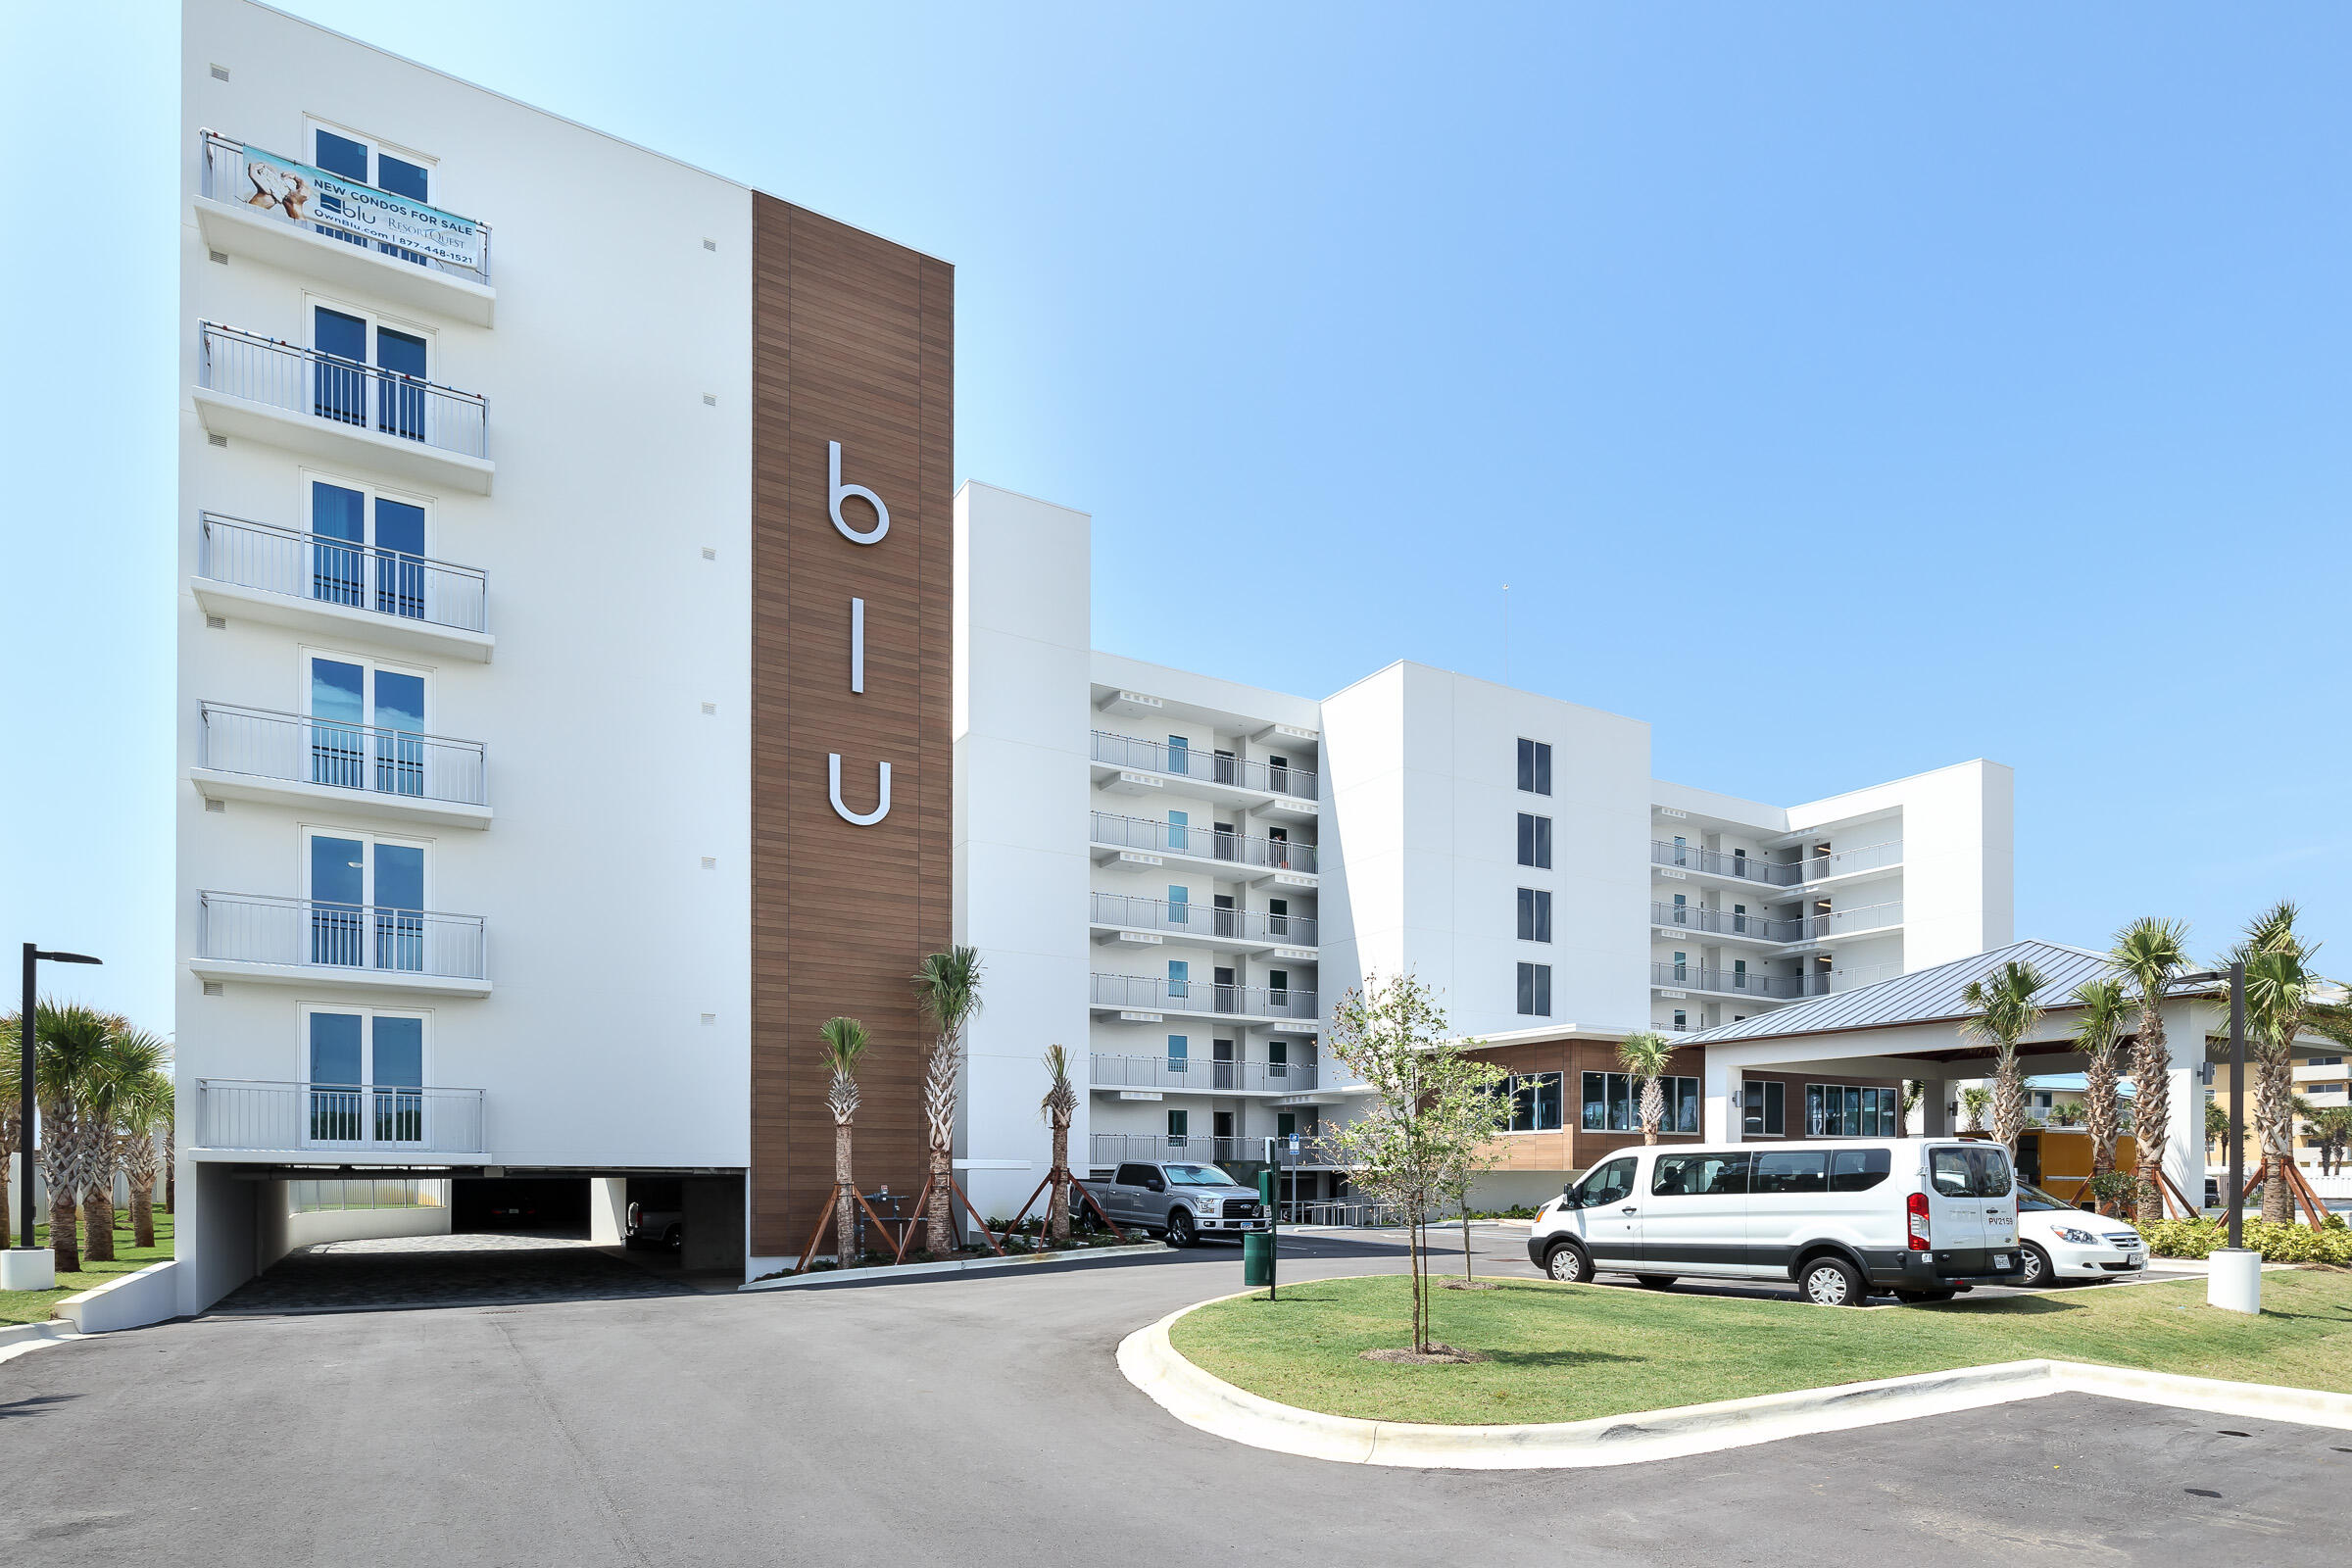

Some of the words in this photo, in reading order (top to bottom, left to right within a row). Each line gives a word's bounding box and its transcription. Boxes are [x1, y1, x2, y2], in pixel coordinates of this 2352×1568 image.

[314, 178, 346, 196] NEW
[350, 191, 407, 216] CONDOS
[411, 210, 437, 225] FOR
[441, 220, 472, 236] SALE
[342, 200, 375, 224] blu
[314, 209, 388, 239] OwnBlu.com
[399, 237, 472, 264] 877-448-1521
[828, 439, 892, 827] blu
